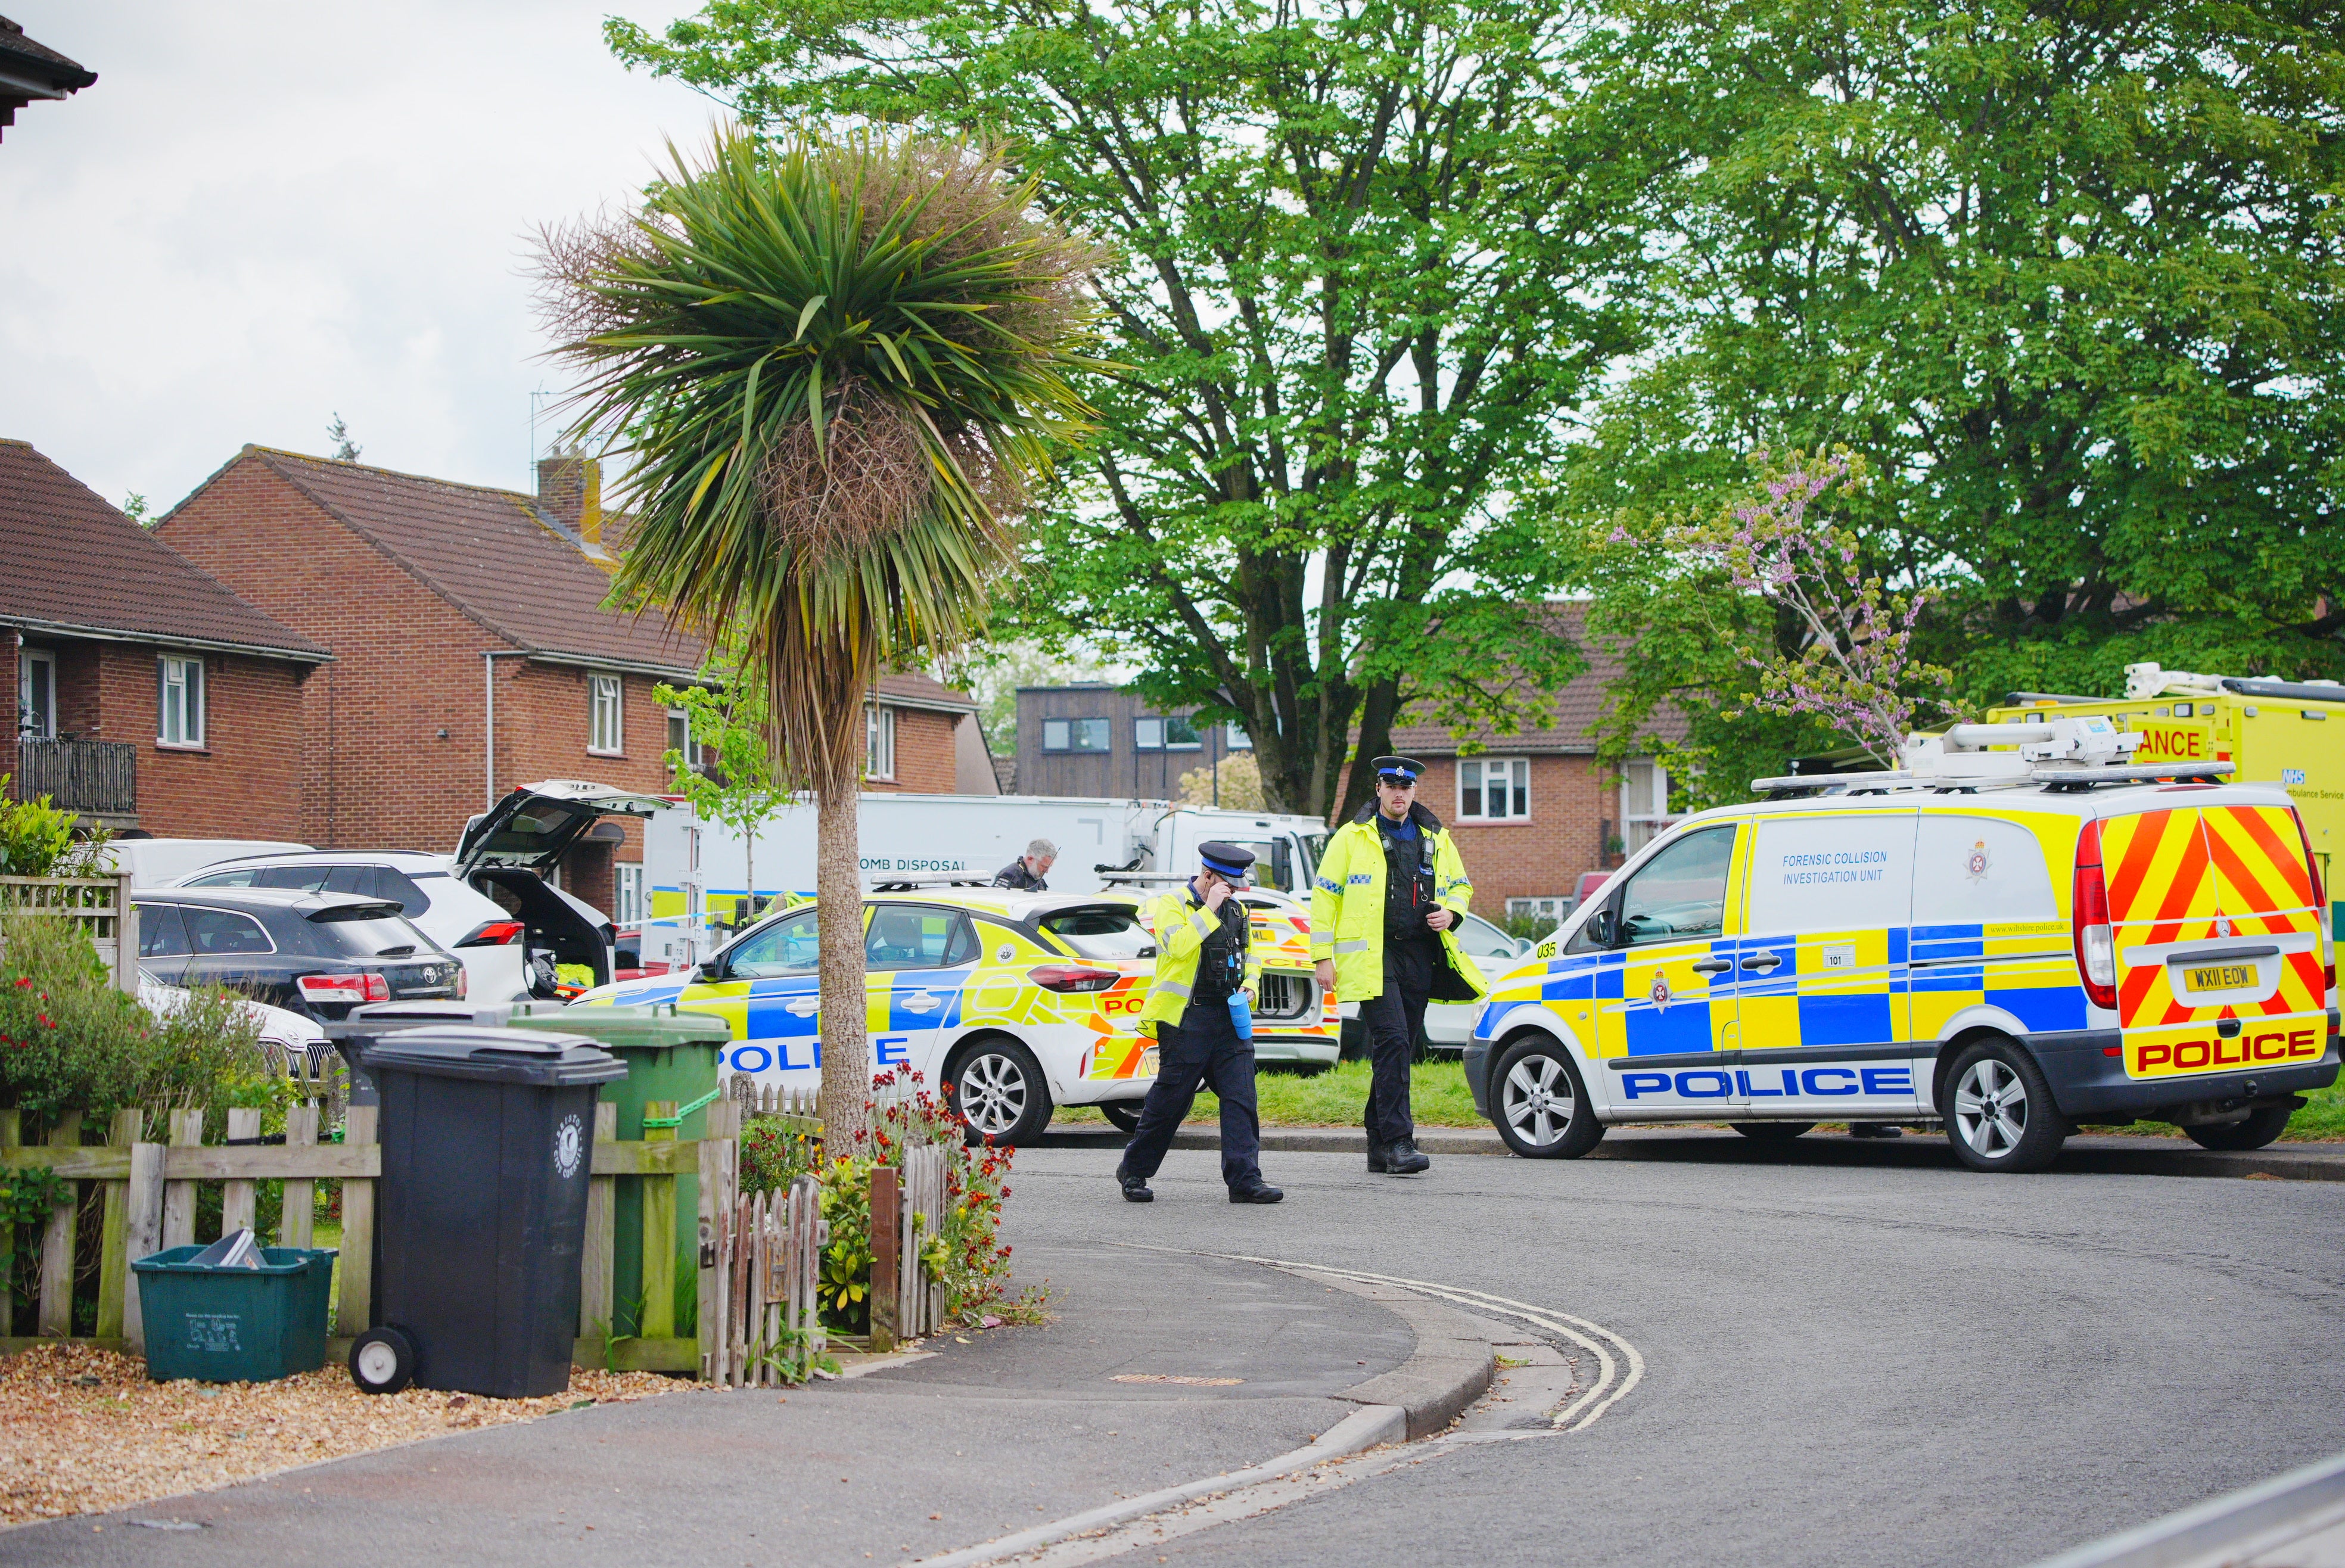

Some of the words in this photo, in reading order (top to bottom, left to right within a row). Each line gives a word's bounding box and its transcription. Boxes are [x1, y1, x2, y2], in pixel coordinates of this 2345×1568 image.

[2134, 729, 2200, 757] ANCE
[2282, 770, 2304, 784] NHS
[2285, 789, 2318, 798] mbulance
[2320, 790, 2344, 799] Service
[860, 858, 890, 870] OMB
[897, 860, 968, 872] DISPOSAL
[1783, 854, 1831, 867] FORENSIC
[1834, 851, 1887, 864] COLLISION
[1784, 870, 1857, 885] INVESTIGATION
[1860, 869, 1883, 882] UNIT
[1991, 923, 2064, 933] www.wiltshire.police.uk
[1537, 941, 1556, 959] 035
[1830, 956, 1841, 966] 101
[2195, 968, 2220, 988] WX11
[2224, 967, 2248, 985] EOW
[719, 1037, 910, 1074] OLIE
[2138, 1029, 2316, 1072] POLICE
[1621, 1068, 1915, 1100] POLICE
[556, 1113, 583, 1138] BRISTOL
[562, 1145, 583, 1178] COUNCIL
